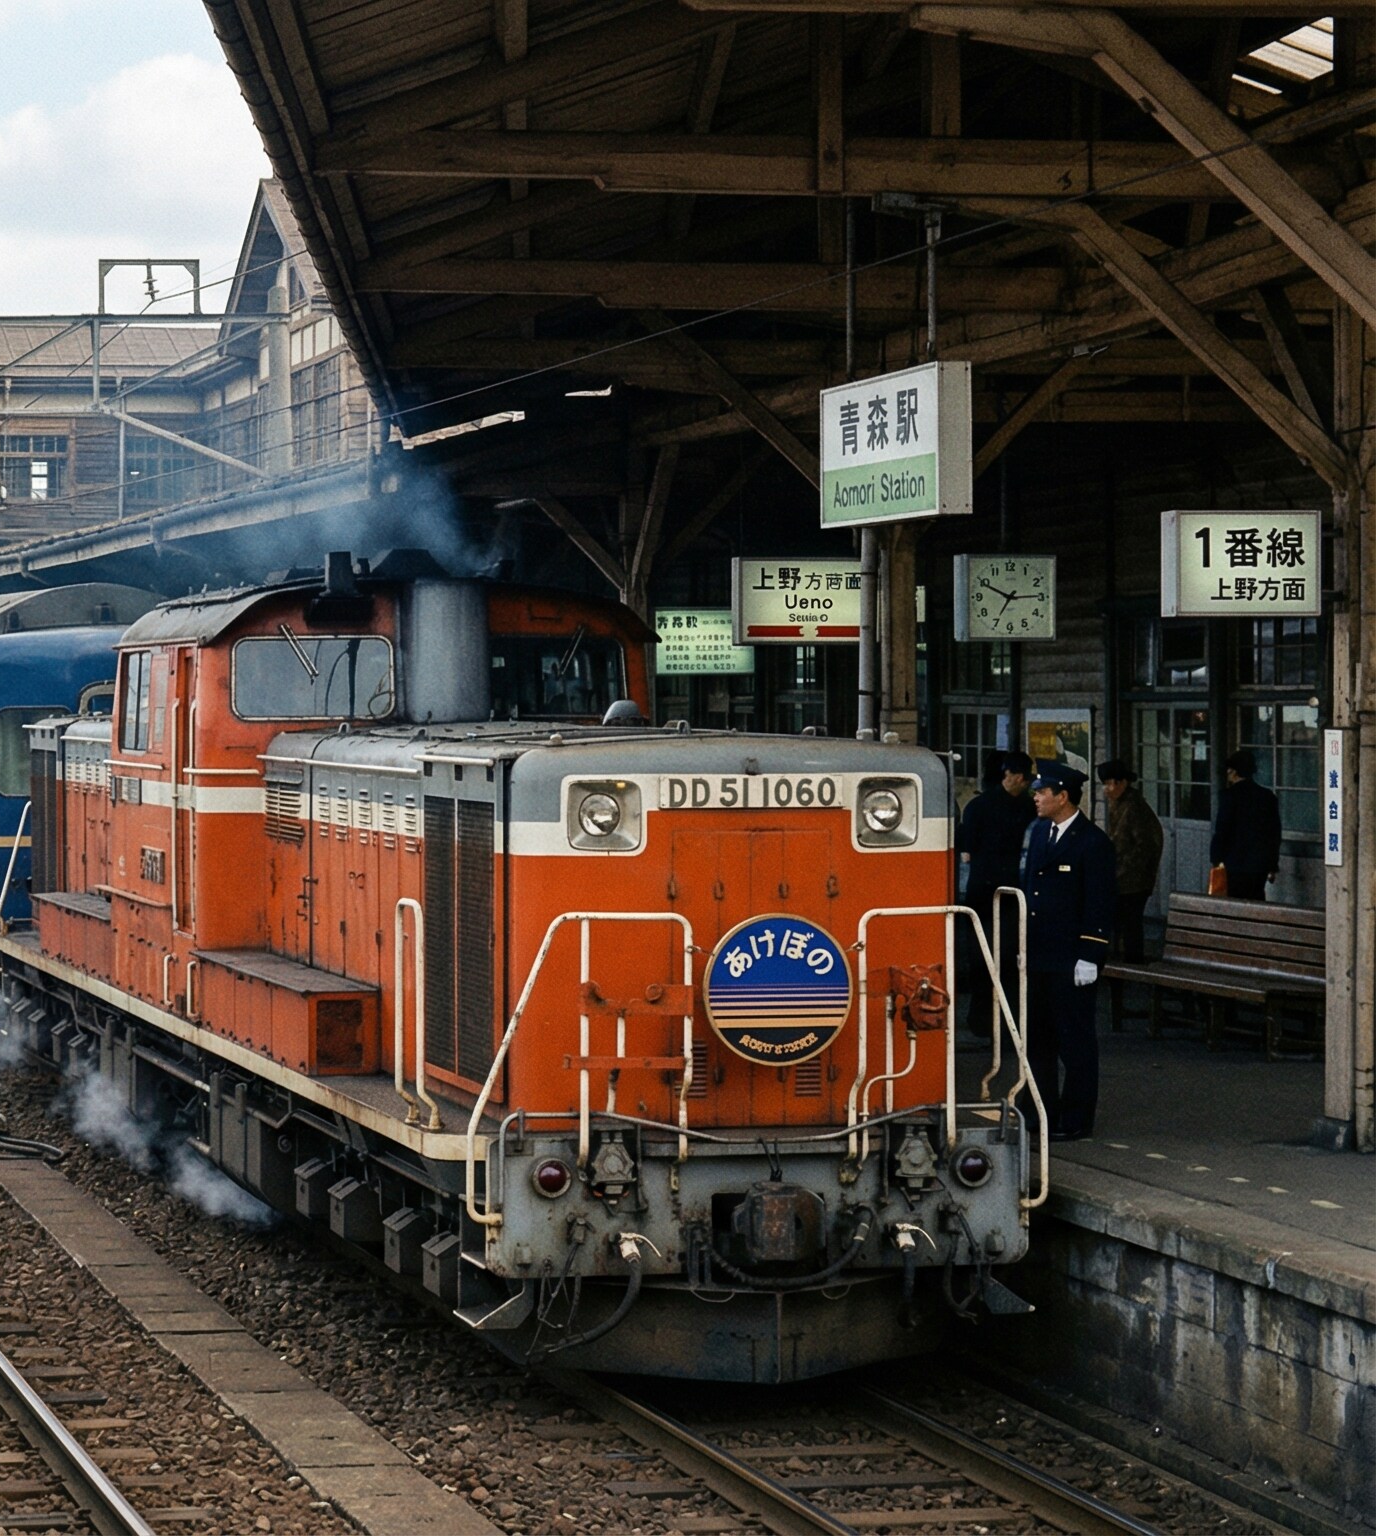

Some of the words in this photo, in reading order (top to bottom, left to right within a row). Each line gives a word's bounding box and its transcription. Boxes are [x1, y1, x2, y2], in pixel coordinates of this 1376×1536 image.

[839, 387, 918, 456] 青森駅
[833, 475, 875, 508] Aomori
[880, 470, 925, 502] Station
[1195, 527, 1306, 568] 1番線
[1032, 578, 1041, 587] 2
[1210, 576, 1306, 601] 上野方面
[785, 594, 833, 609] Ueno
[975, 592, 983, 602] 9
[980, 607, 988, 617] 8
[1031, 608, 1039, 617] 4
[992, 618, 1000, 627] 7
[763, 777, 836, 807] 1060
[723, 929, 834, 978] あけぼの
